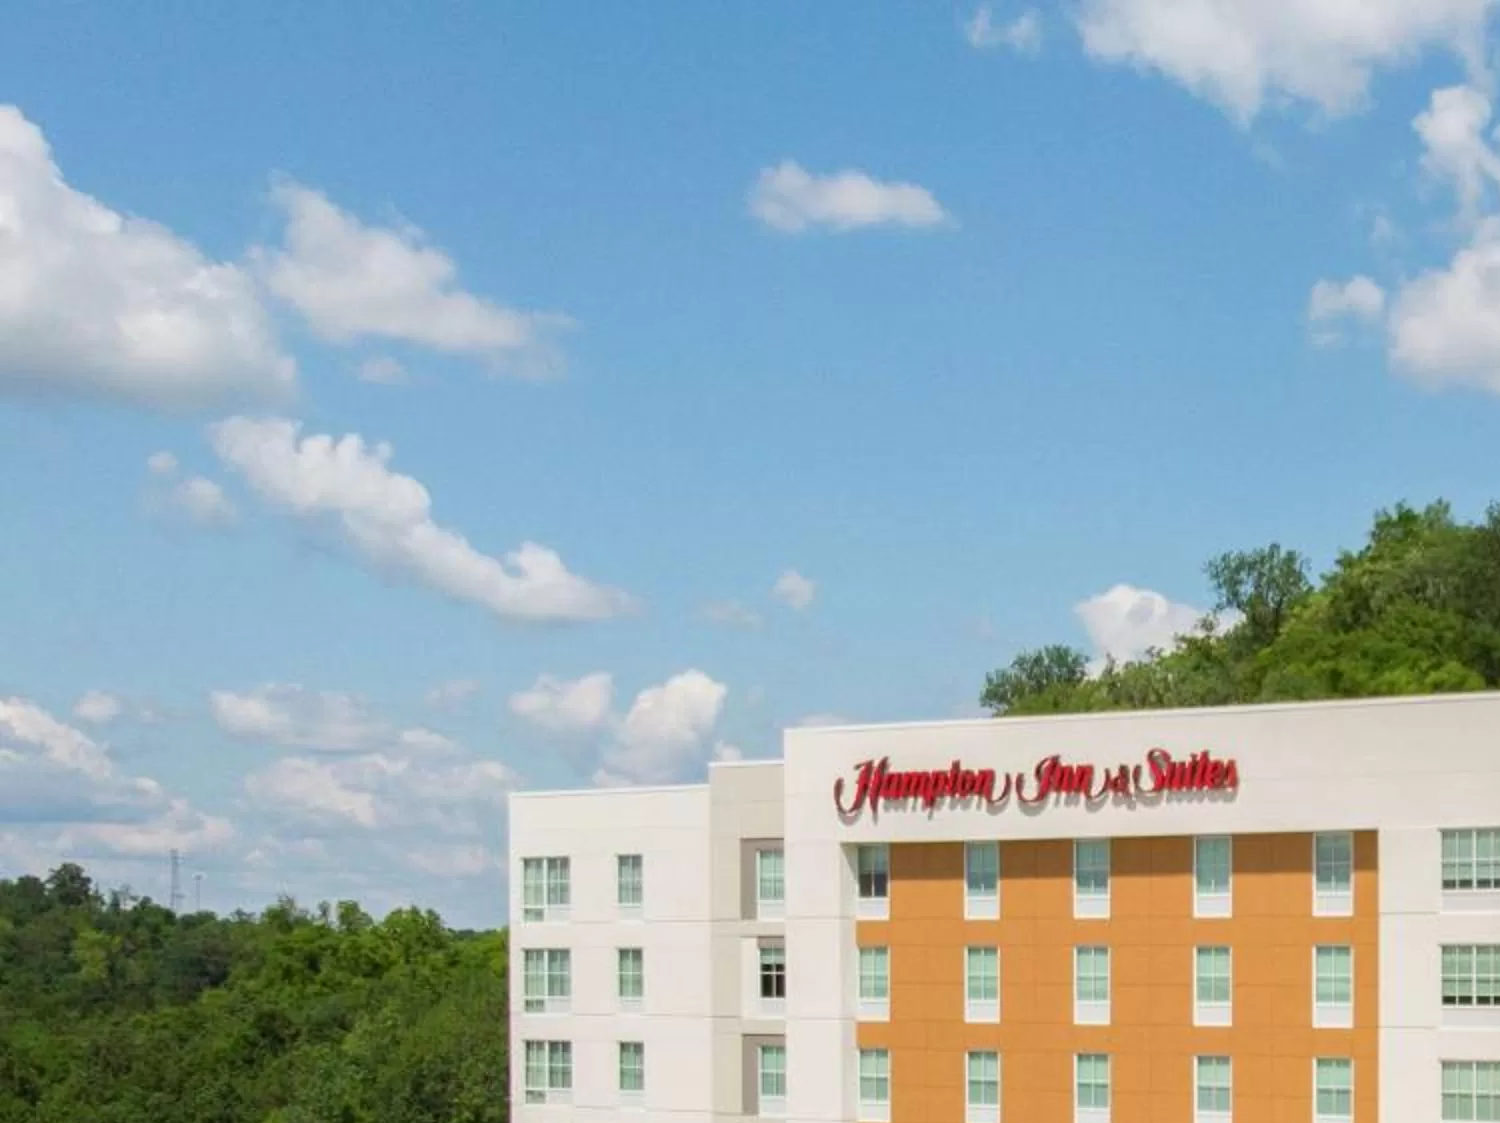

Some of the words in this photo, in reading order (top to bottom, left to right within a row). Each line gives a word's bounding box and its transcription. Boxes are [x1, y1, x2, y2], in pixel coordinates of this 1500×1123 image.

[834, 756, 1012, 815] Hampton
[1016, 755, 1110, 803] Inn
[1132, 748, 1238, 794] Suites
